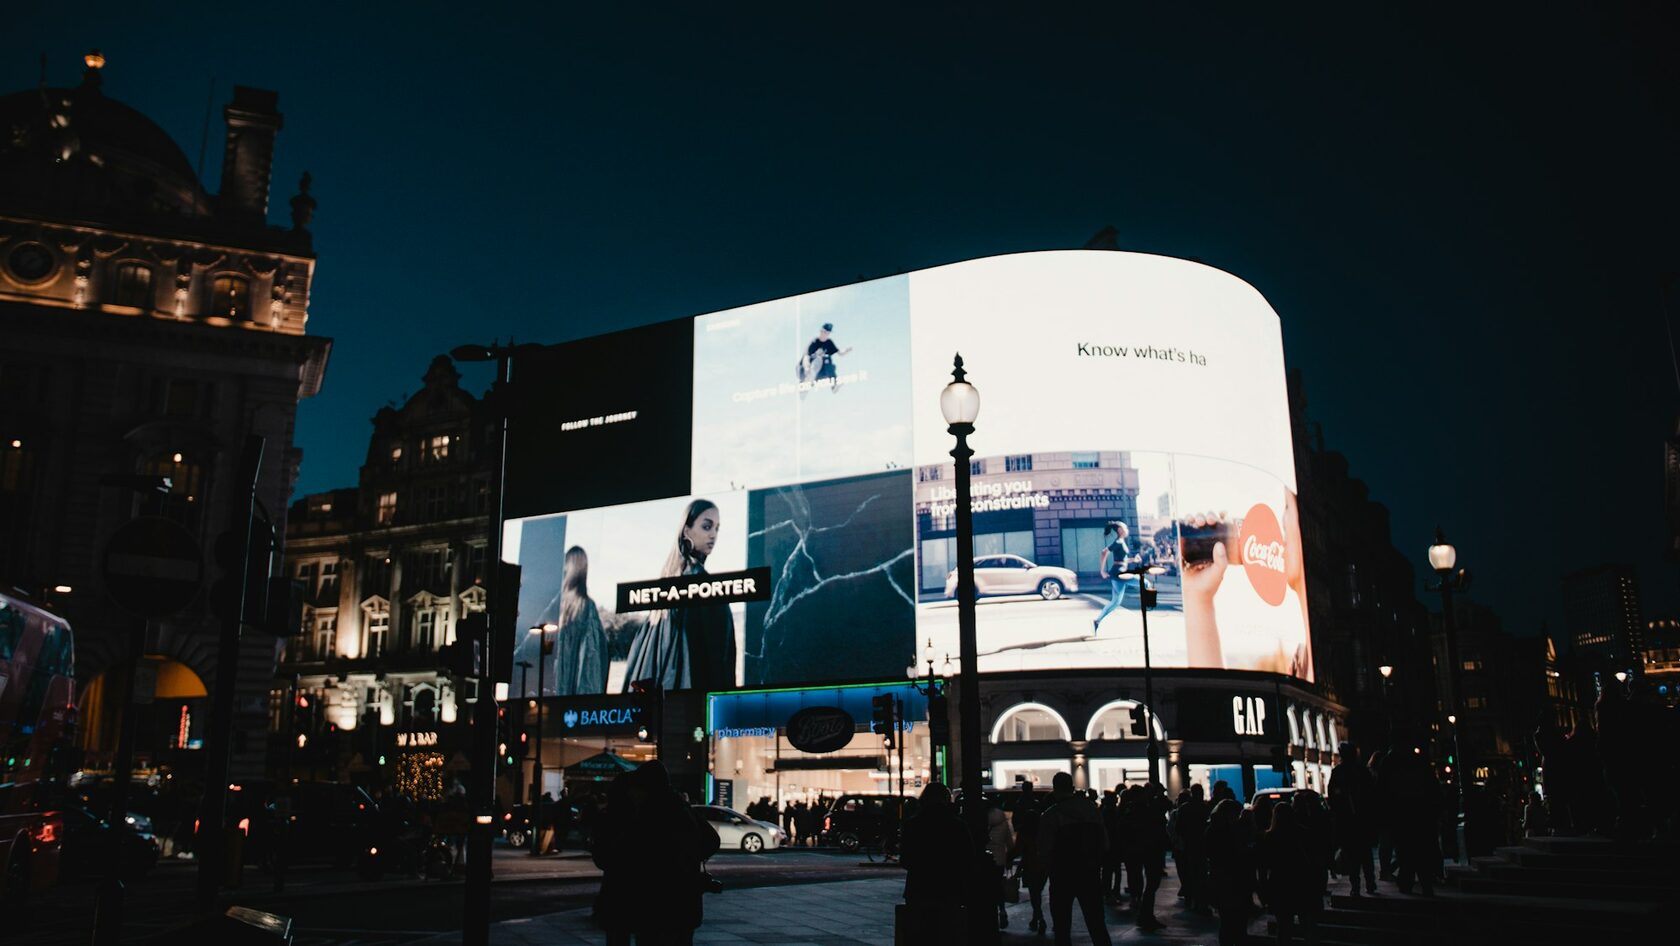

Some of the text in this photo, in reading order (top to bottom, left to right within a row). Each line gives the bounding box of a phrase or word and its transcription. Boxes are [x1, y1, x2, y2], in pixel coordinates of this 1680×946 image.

[1077, 342, 1207, 366] Know what's ha
[814, 378, 835, 392] you
[561, 410, 638, 431] FOLLOW THE JOURNEY
[930, 480, 1033, 501] Libting you
[628, 577, 757, 605] NET-A-PORTER
[580, 708, 642, 726] BARCLA
[1232, 695, 1266, 736] GAP
[417, 731, 438, 746] BAR
[718, 726, 776, 741] pharmacy
